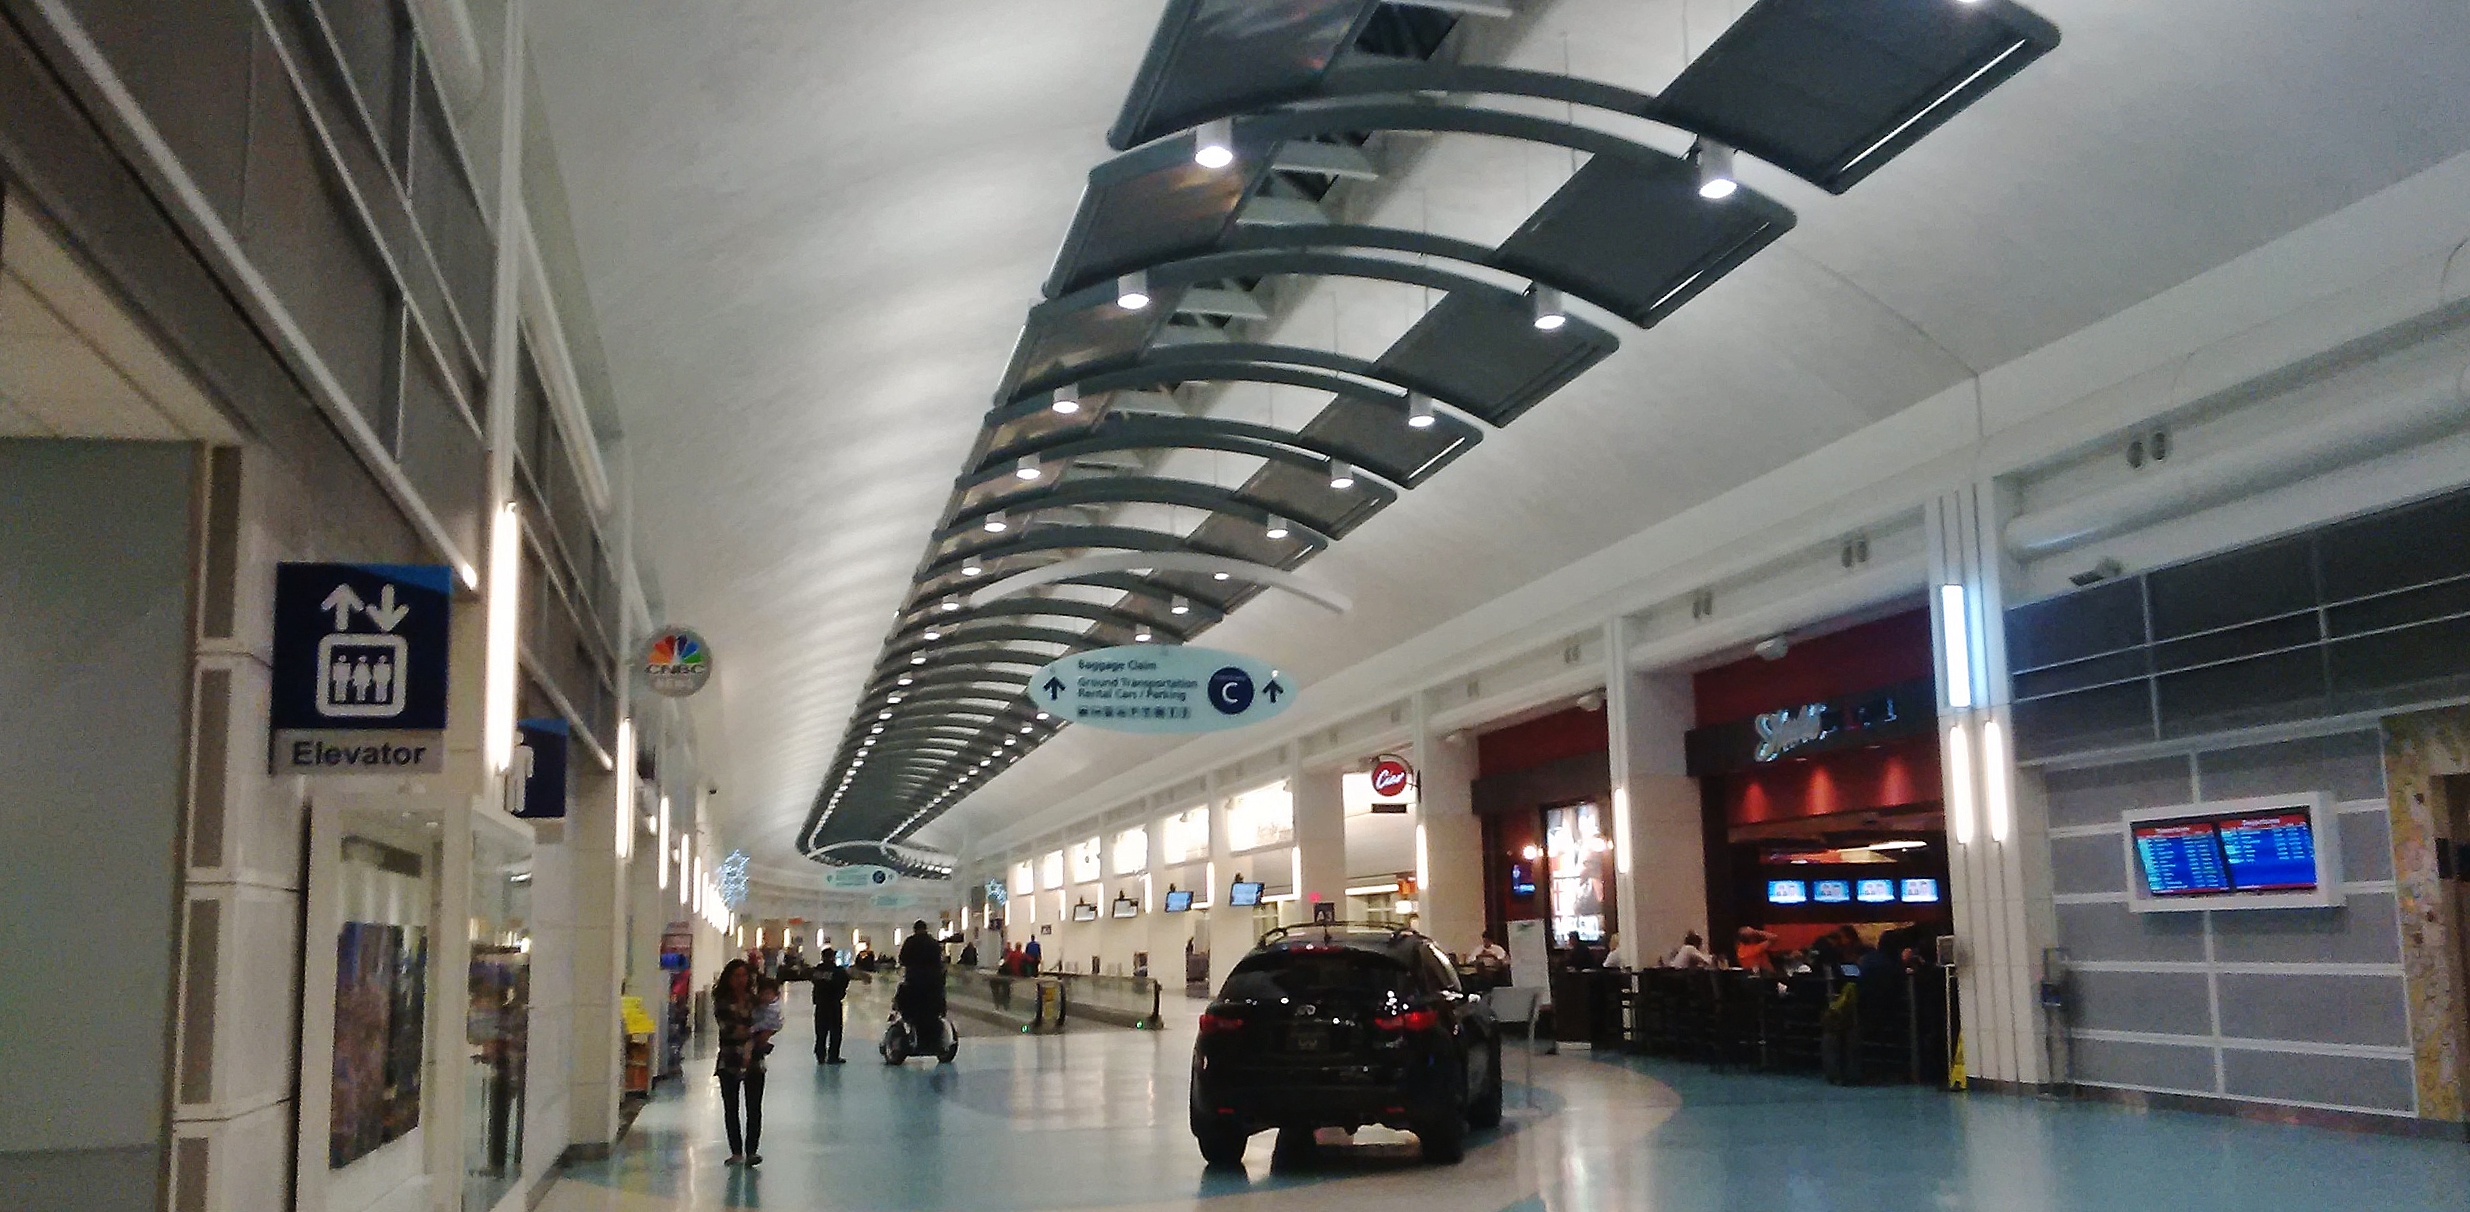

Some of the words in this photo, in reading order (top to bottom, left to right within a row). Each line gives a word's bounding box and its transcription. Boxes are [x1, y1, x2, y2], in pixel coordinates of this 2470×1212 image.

[644, 664, 705, 674] CNBC
[1078, 659, 1125, 672] Baggage
[1127, 659, 1157, 670] Claim
[1077, 676, 1118, 687] Ground
[1120, 677, 1198, 688] Transportation
[1078, 688, 1112, 698] Rental
[1115, 688, 1137, 699] Cars
[1146, 687, 1187, 702] Parking
[1222, 681, 1238, 703] C
[293, 739, 427, 766] Elevator
